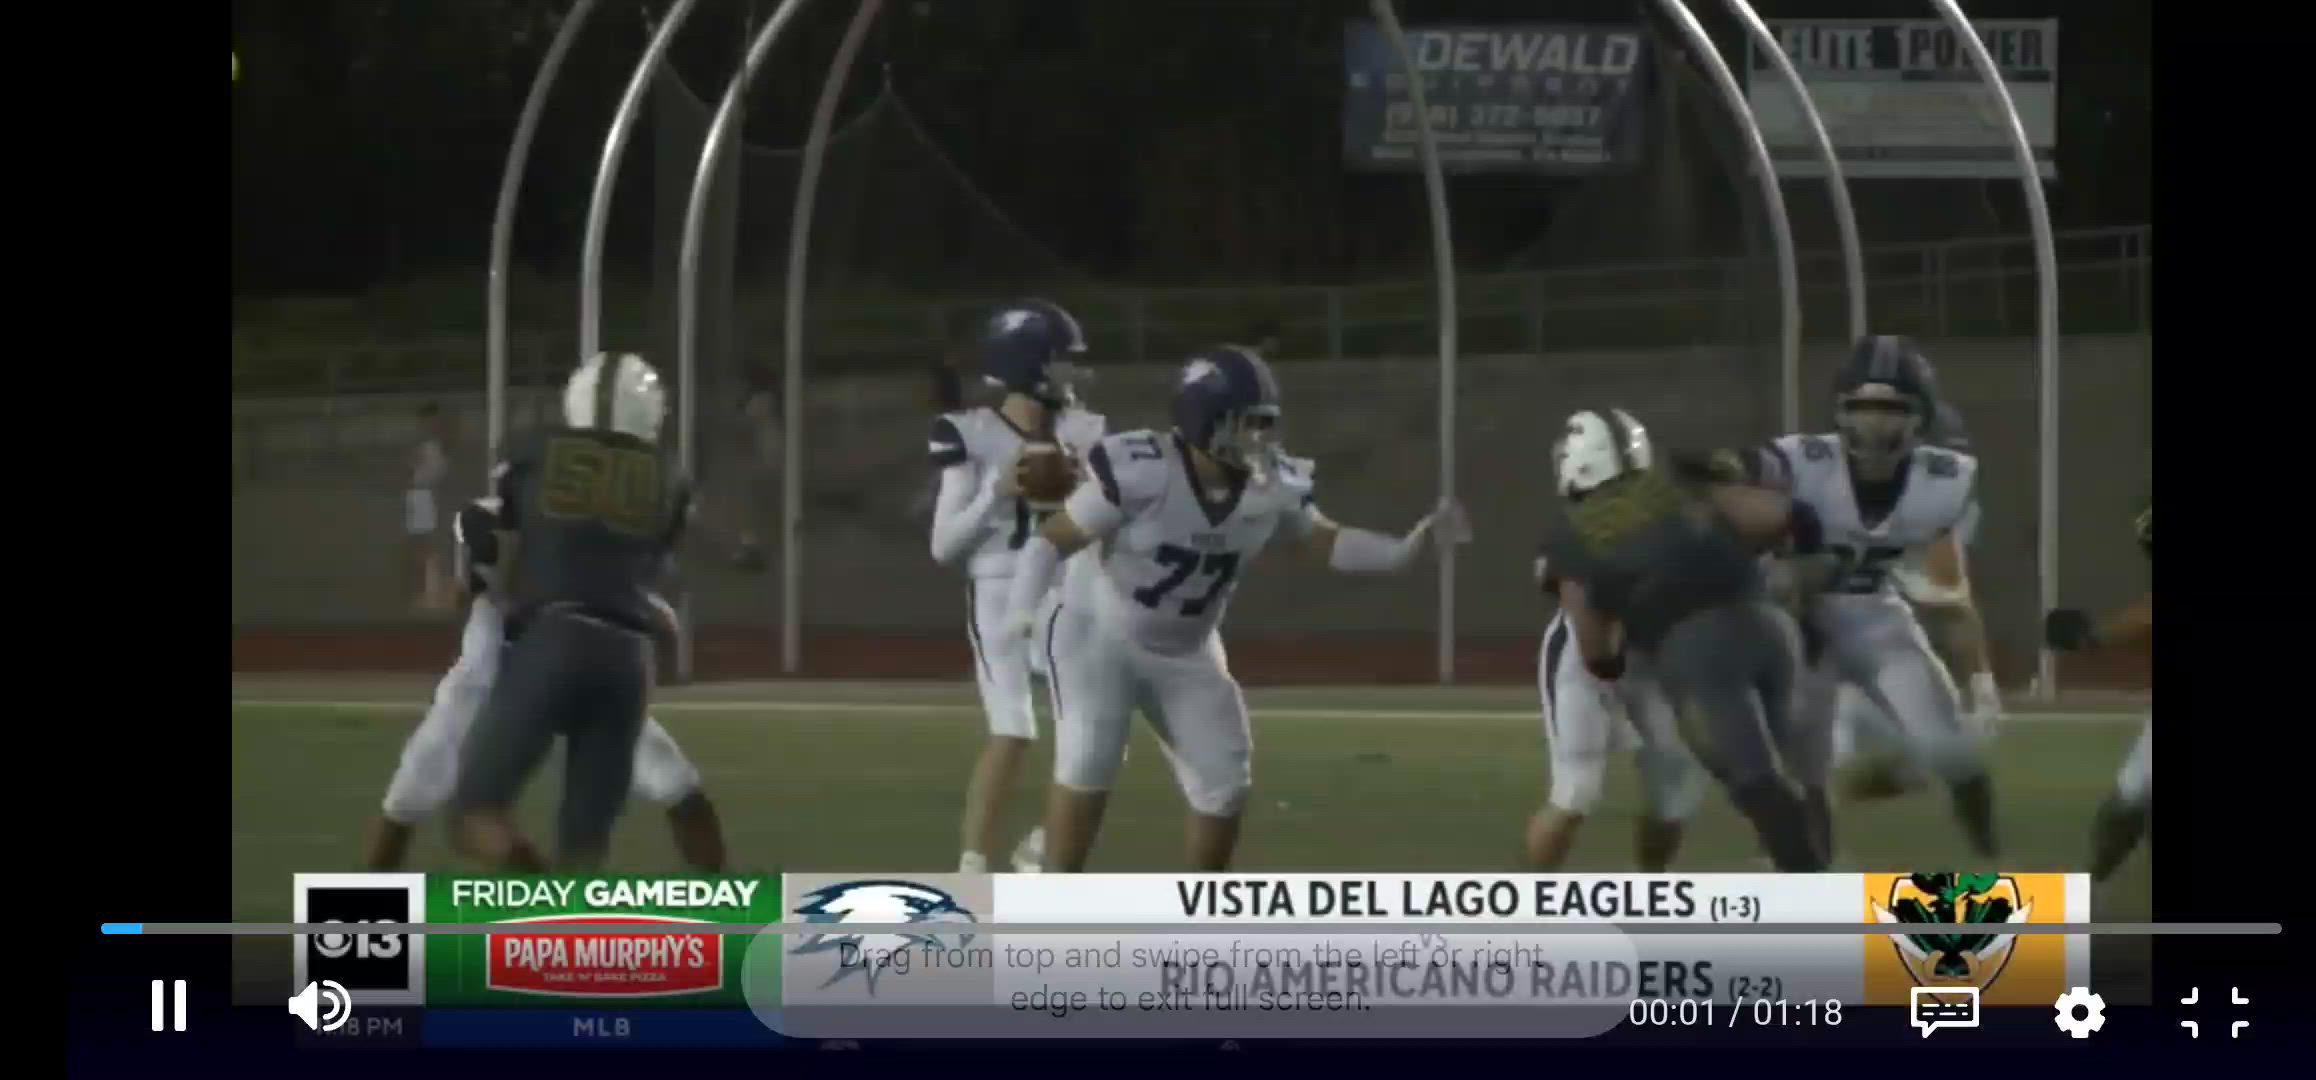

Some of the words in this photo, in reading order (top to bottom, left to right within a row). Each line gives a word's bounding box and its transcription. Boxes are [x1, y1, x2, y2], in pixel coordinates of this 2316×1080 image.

[1414, 31, 1639, 75] DEWALD
[1781, 26, 1873, 69] ELITE
[1133, 544, 1241, 616] 77
